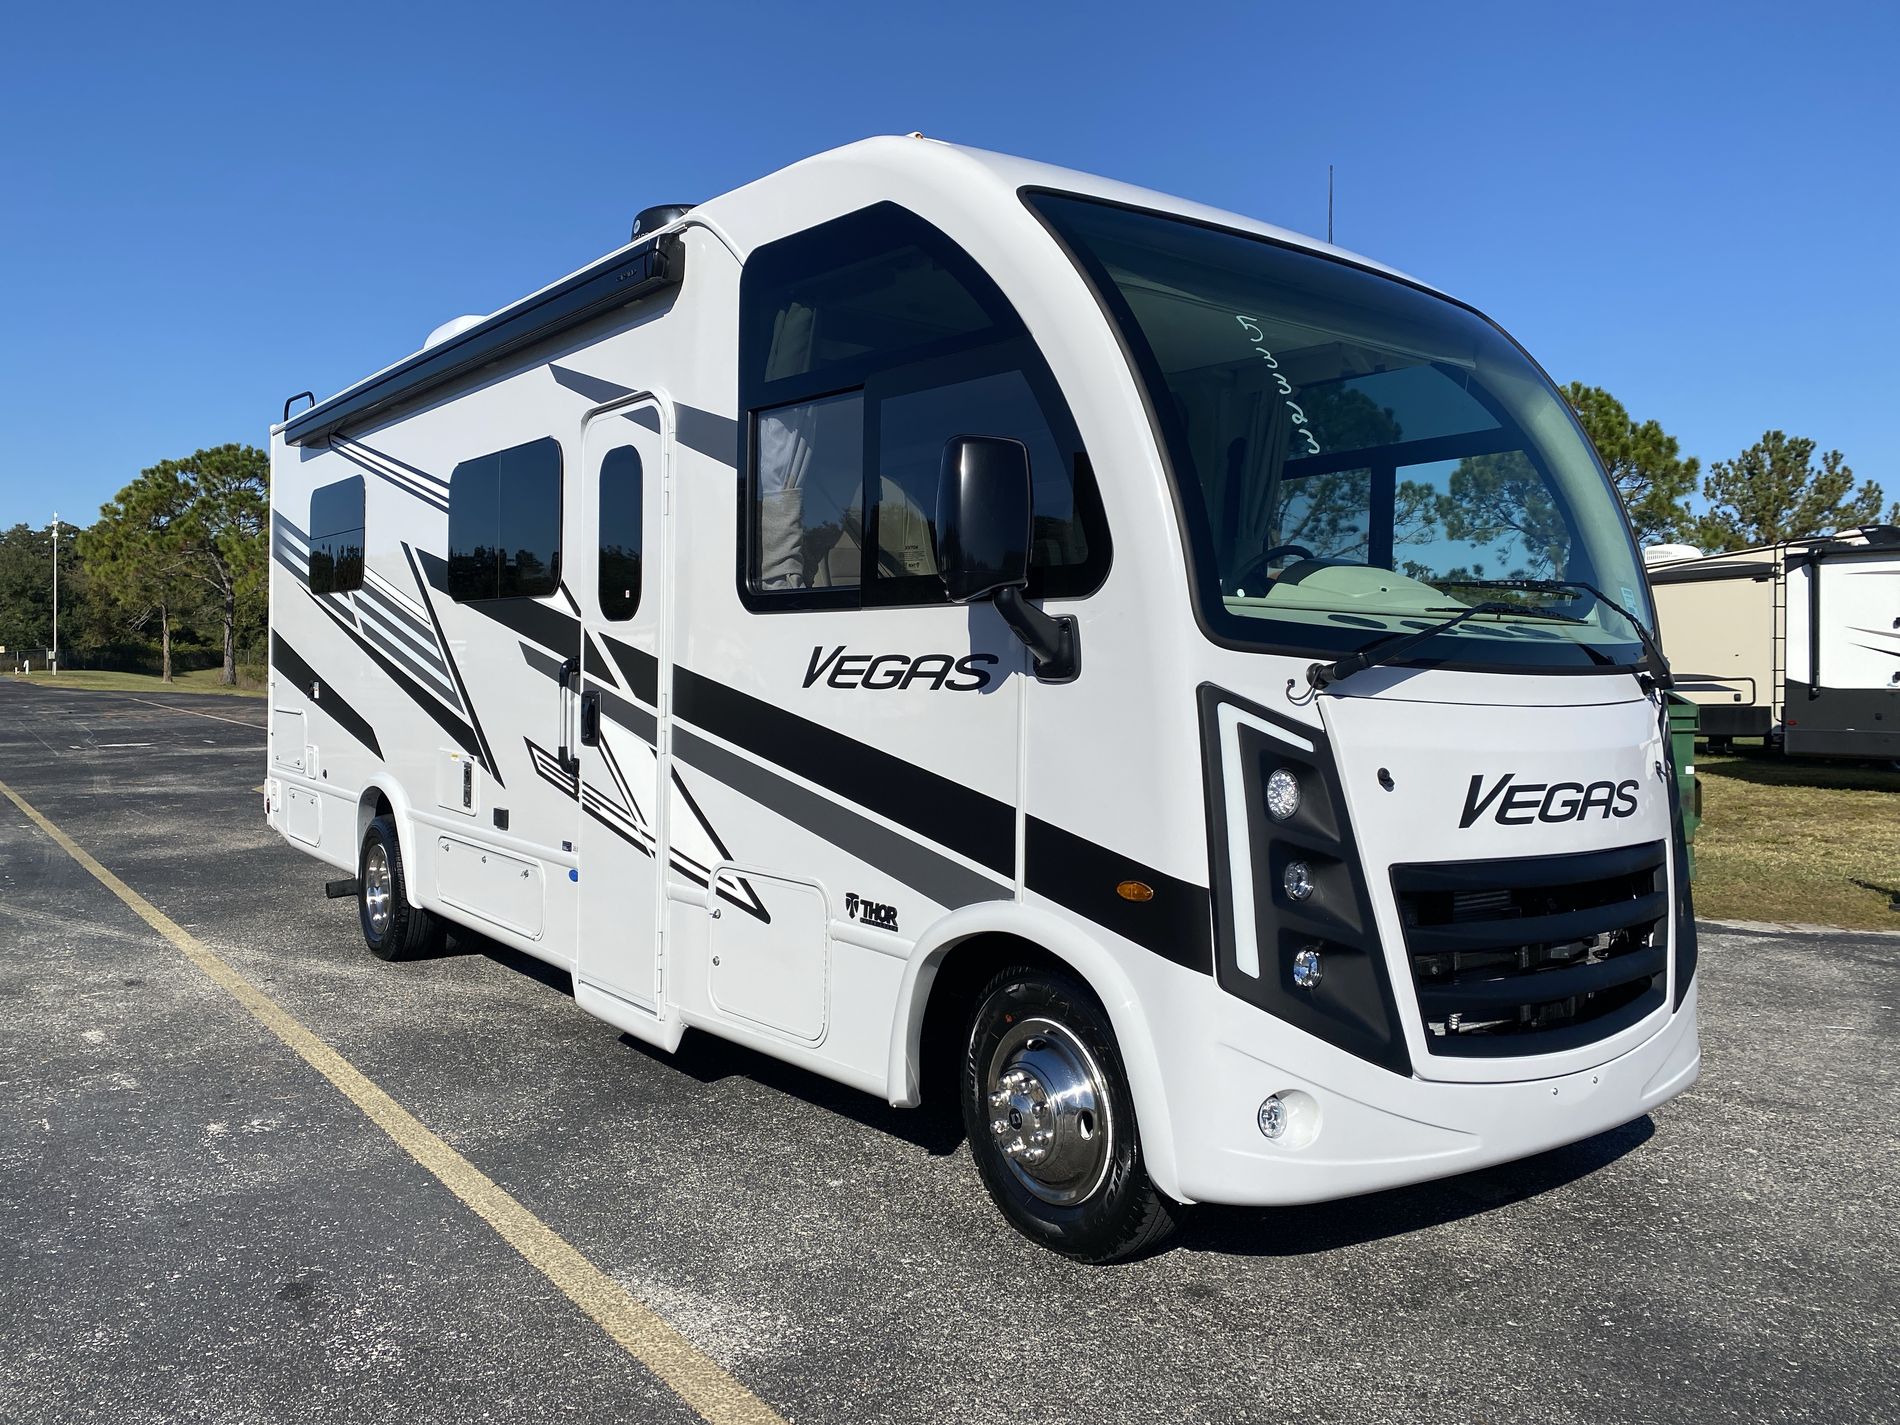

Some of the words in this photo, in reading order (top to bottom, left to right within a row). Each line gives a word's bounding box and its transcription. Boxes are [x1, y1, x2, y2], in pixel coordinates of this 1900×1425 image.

[802, 645, 999, 691] VEGAS
[1459, 773, 1640, 829] VEGAS
[860, 899, 898, 926] THOR
